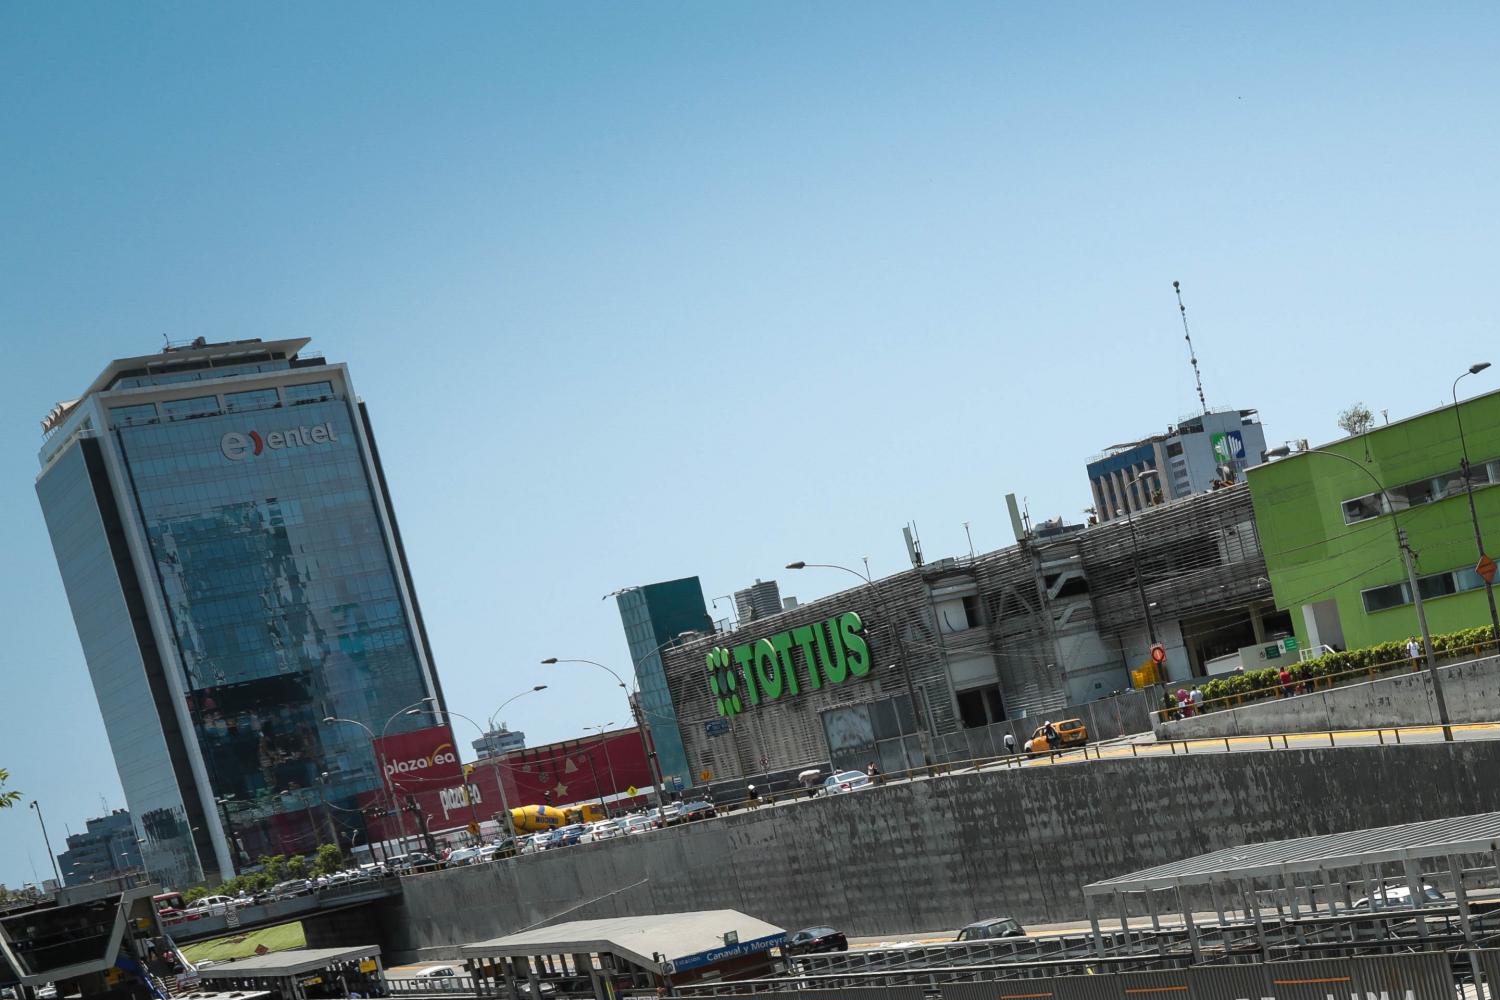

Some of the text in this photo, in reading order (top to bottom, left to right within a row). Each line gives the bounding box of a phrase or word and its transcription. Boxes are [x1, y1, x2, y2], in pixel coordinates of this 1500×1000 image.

[266, 421, 337, 450] entel
[733, 611, 871, 705] TOTTUS
[706, 944, 741, 962] Canaval
[743, 945, 750, 954] y
